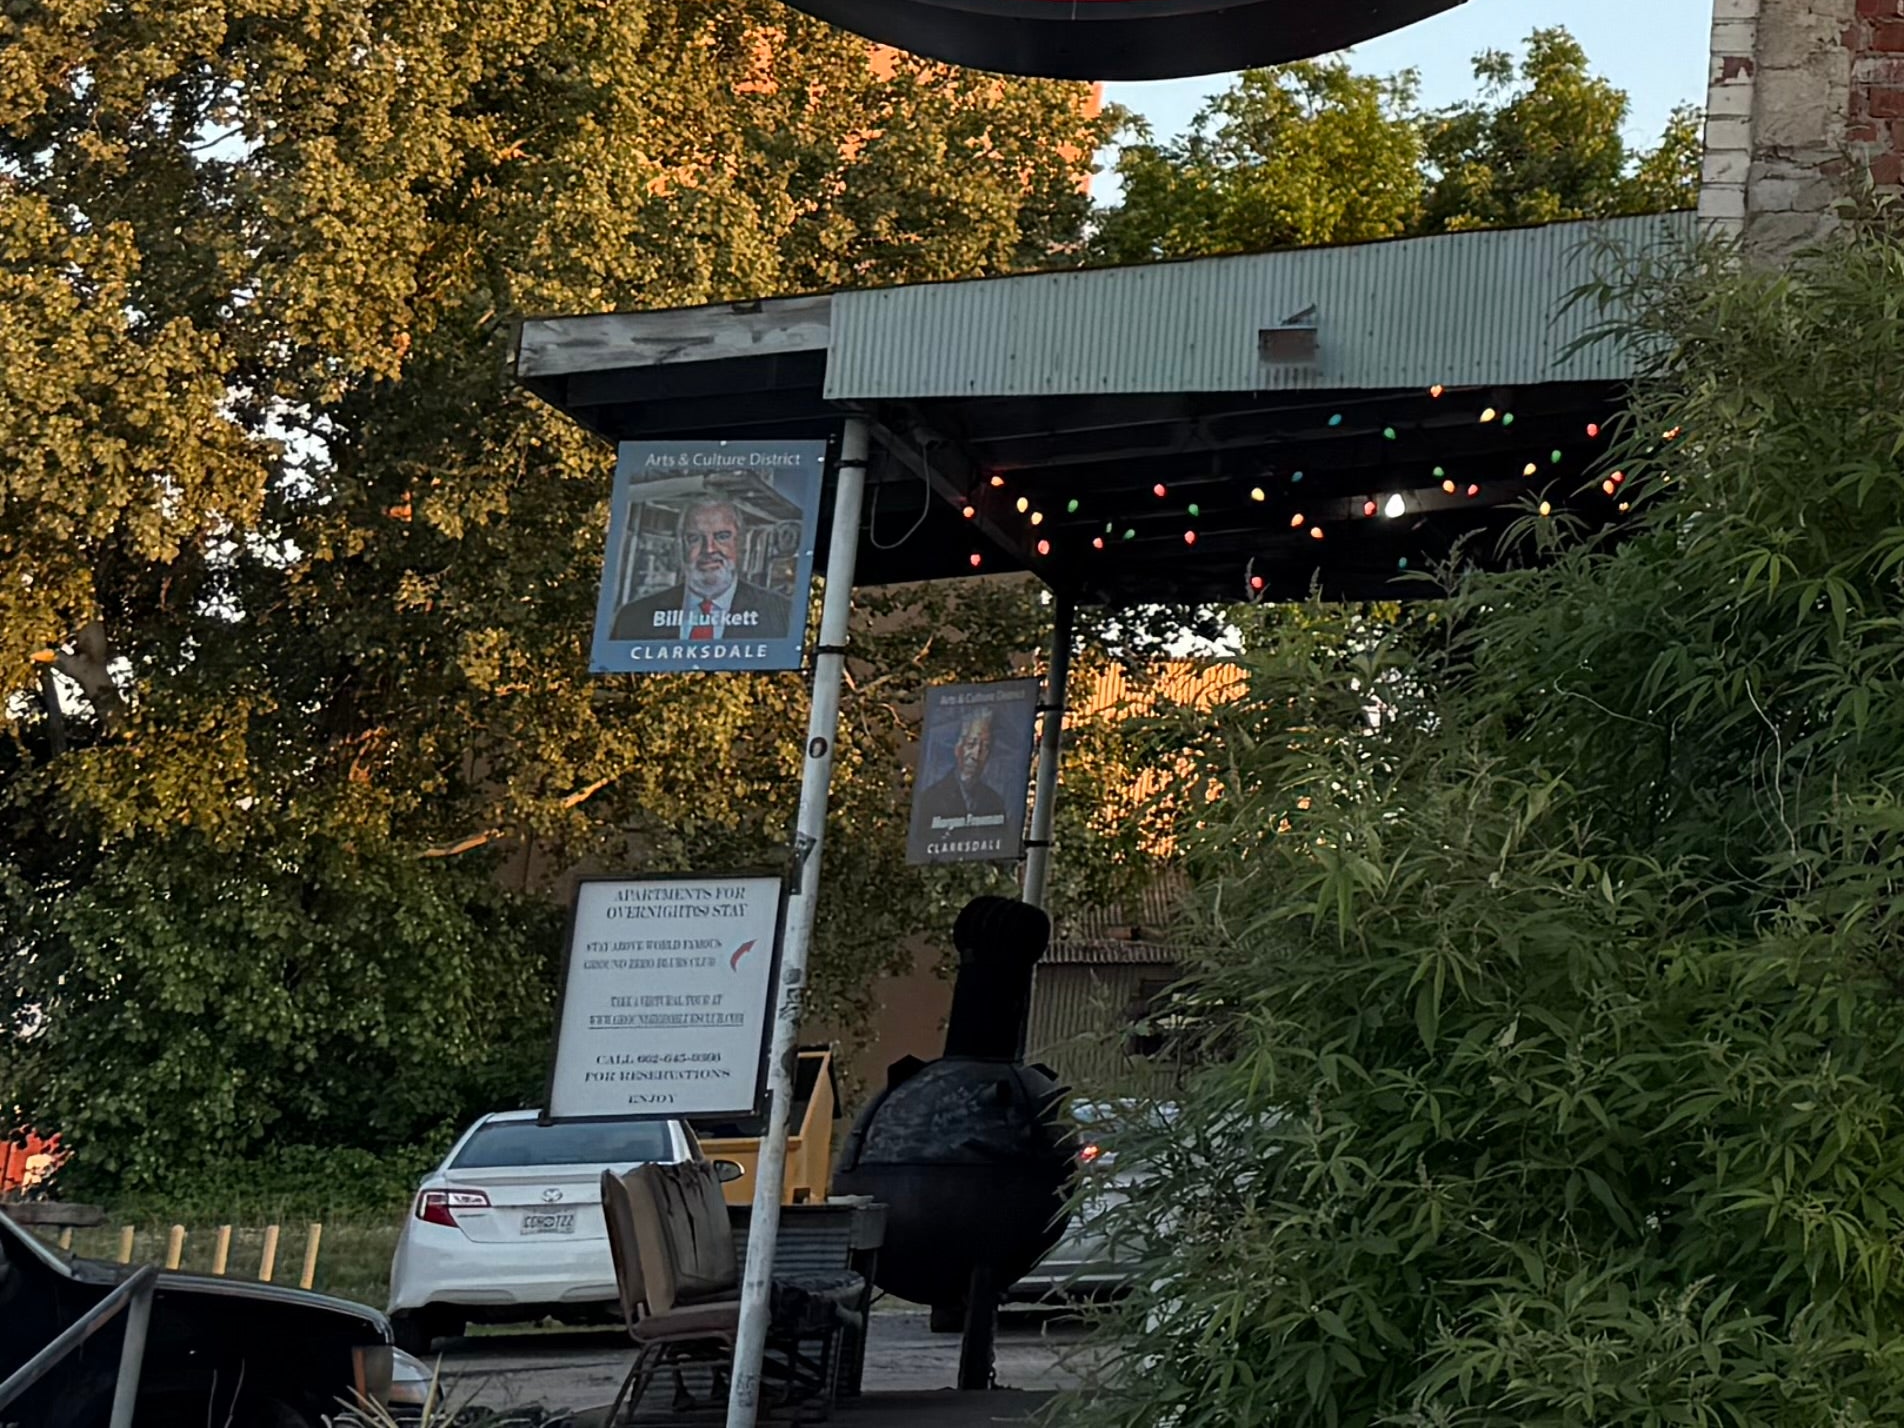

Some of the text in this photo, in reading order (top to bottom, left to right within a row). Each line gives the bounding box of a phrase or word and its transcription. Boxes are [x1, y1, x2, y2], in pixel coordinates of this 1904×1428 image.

[645, 452, 800, 467] Arts & Culture District
[653, 610, 760, 627] Bill Luckett
[630, 644, 768, 660] CLARKSDALE
[615, 886, 746, 902] APARTMENTS FOR
[711, 903, 749, 918] STAY
[596, 1054, 634, 1065] CALL
[585, 1068, 731, 1082] FOR RESERVATIONS
